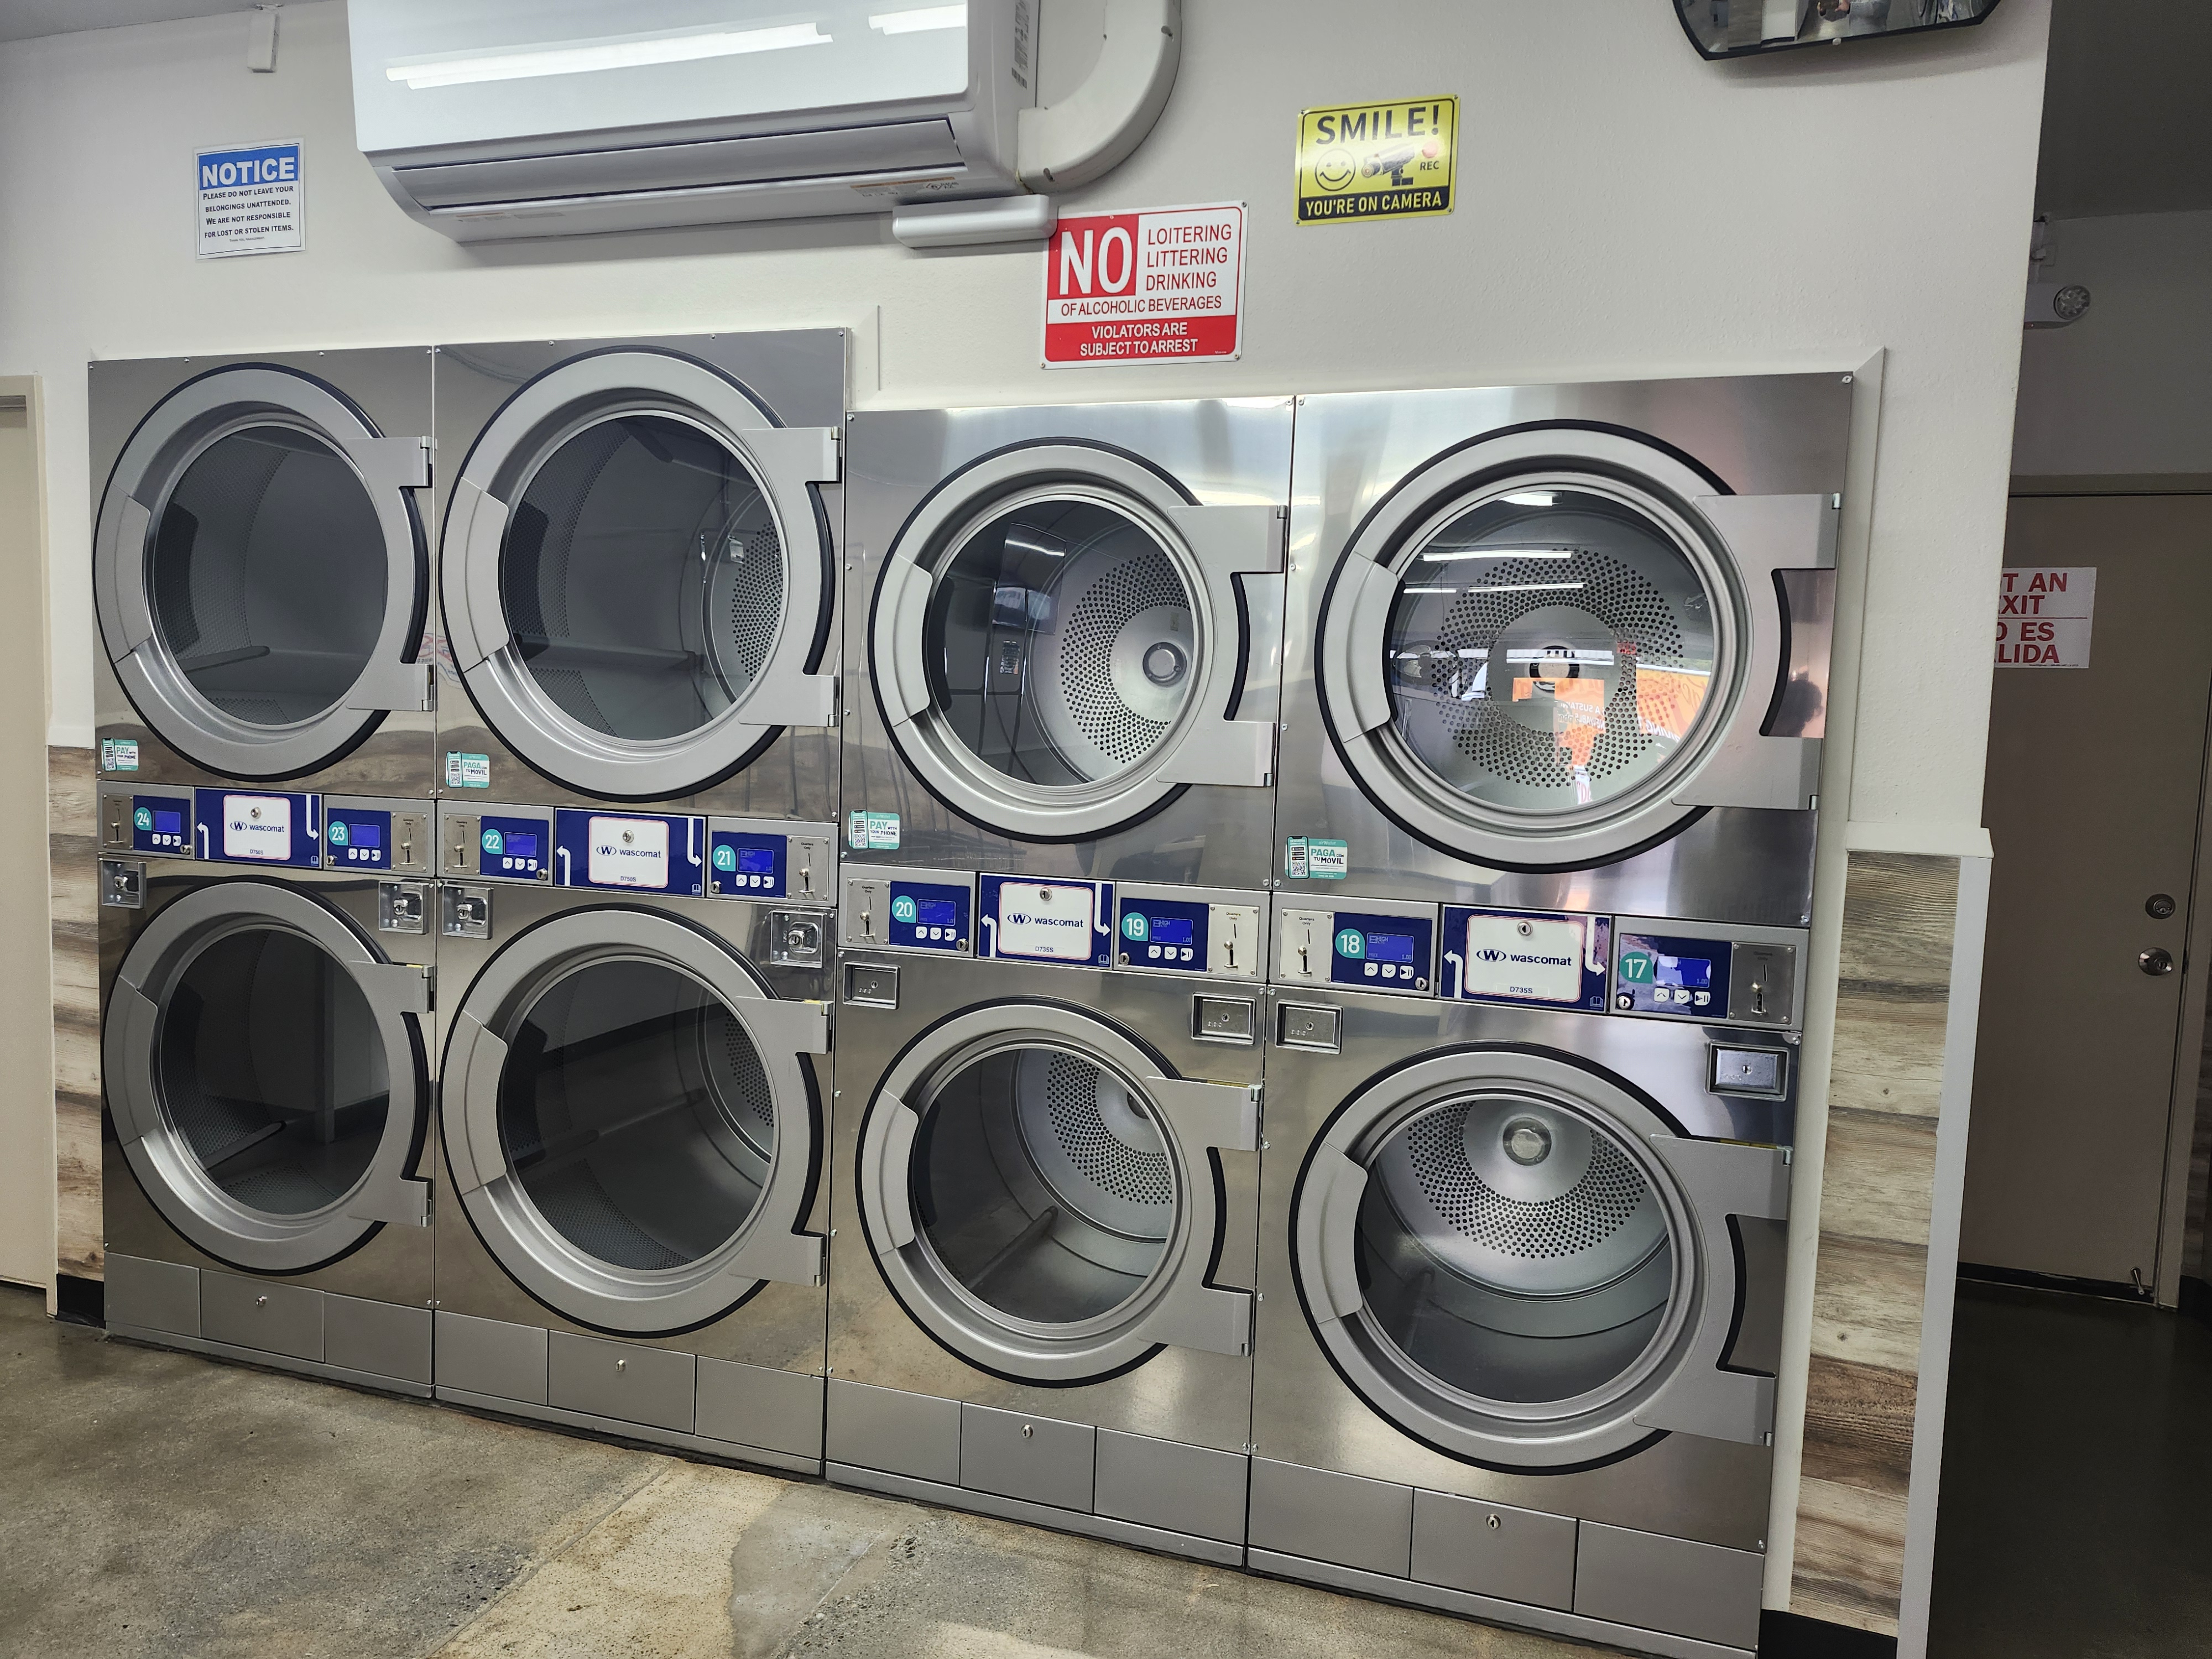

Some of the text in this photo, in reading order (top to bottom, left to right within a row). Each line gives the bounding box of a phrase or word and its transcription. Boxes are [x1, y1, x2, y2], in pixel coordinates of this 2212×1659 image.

[1316, 104, 1439, 145] SMILE!
[202, 157, 295, 187] NOTICE
[1420, 160, 1439, 171] REC
[203, 192, 226, 200] PLEASE
[1306, 191, 1442, 217] YOU'RE ON CAMERA
[206, 199, 291, 212] BELONGINGS UNATTENDED.
[246, 212, 290, 221] RESPONSIBLE
[1148, 224, 1232, 245] LOITERING
[1059, 227, 1133, 295] NO
[1147, 247, 1228, 268] LITTERING
[1146, 272, 1217, 291] DRINKING
[1061, 295, 1222, 316] OF ALCOHOLIC BEVERAGES
[1092, 322, 1188, 339] VIOLATORS ARE
[1080, 338, 1198, 356] SUBJECT TO ARREST
[2028, 573, 2068, 592] AN
[1999, 595, 2045, 614] XIT
[1996, 622, 2054, 641] O ES
[1995, 644, 2059, 663] LIDA
[138, 812, 150, 826] 24
[870, 821, 888, 830] PAY
[332, 827, 345, 841] 23
[485, 834, 499, 849] 22
[619, 849, 661, 858] wascomat
[717, 851, 730, 865] 21
[1311, 848, 1335, 857] PAGA
[896, 902, 912, 917] 20
[1035, 917, 1083, 927] wascomat
[1126, 918, 1144, 936] 19
[1341, 935, 1360, 954] 18
[1510, 953, 1572, 966] wascomat
[1625, 958, 1647, 979] 17
[1510, 986, 1533, 994] D735S
